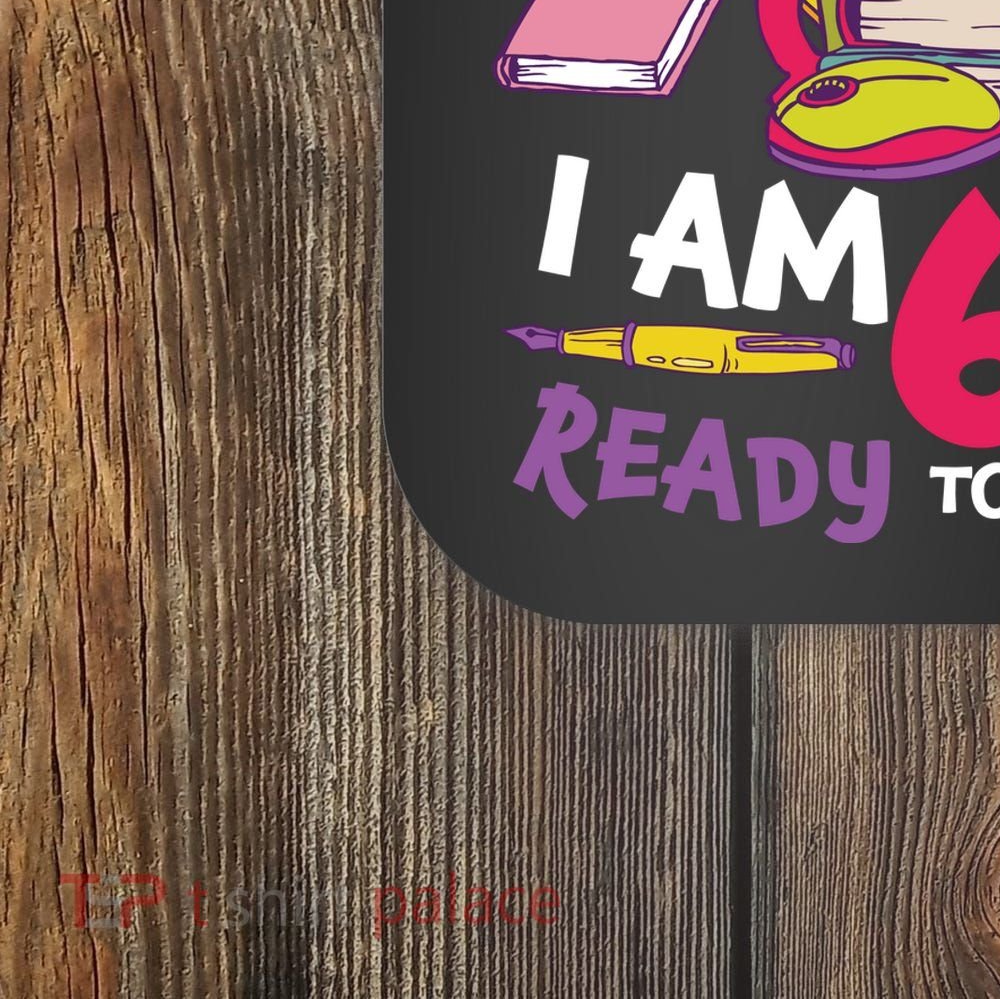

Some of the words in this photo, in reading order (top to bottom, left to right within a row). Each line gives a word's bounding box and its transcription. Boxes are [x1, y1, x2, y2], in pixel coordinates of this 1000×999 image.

[538, 154, 590, 277] I
[629, 172, 888, 325] AM
[513, 382, 890, 543] READY
